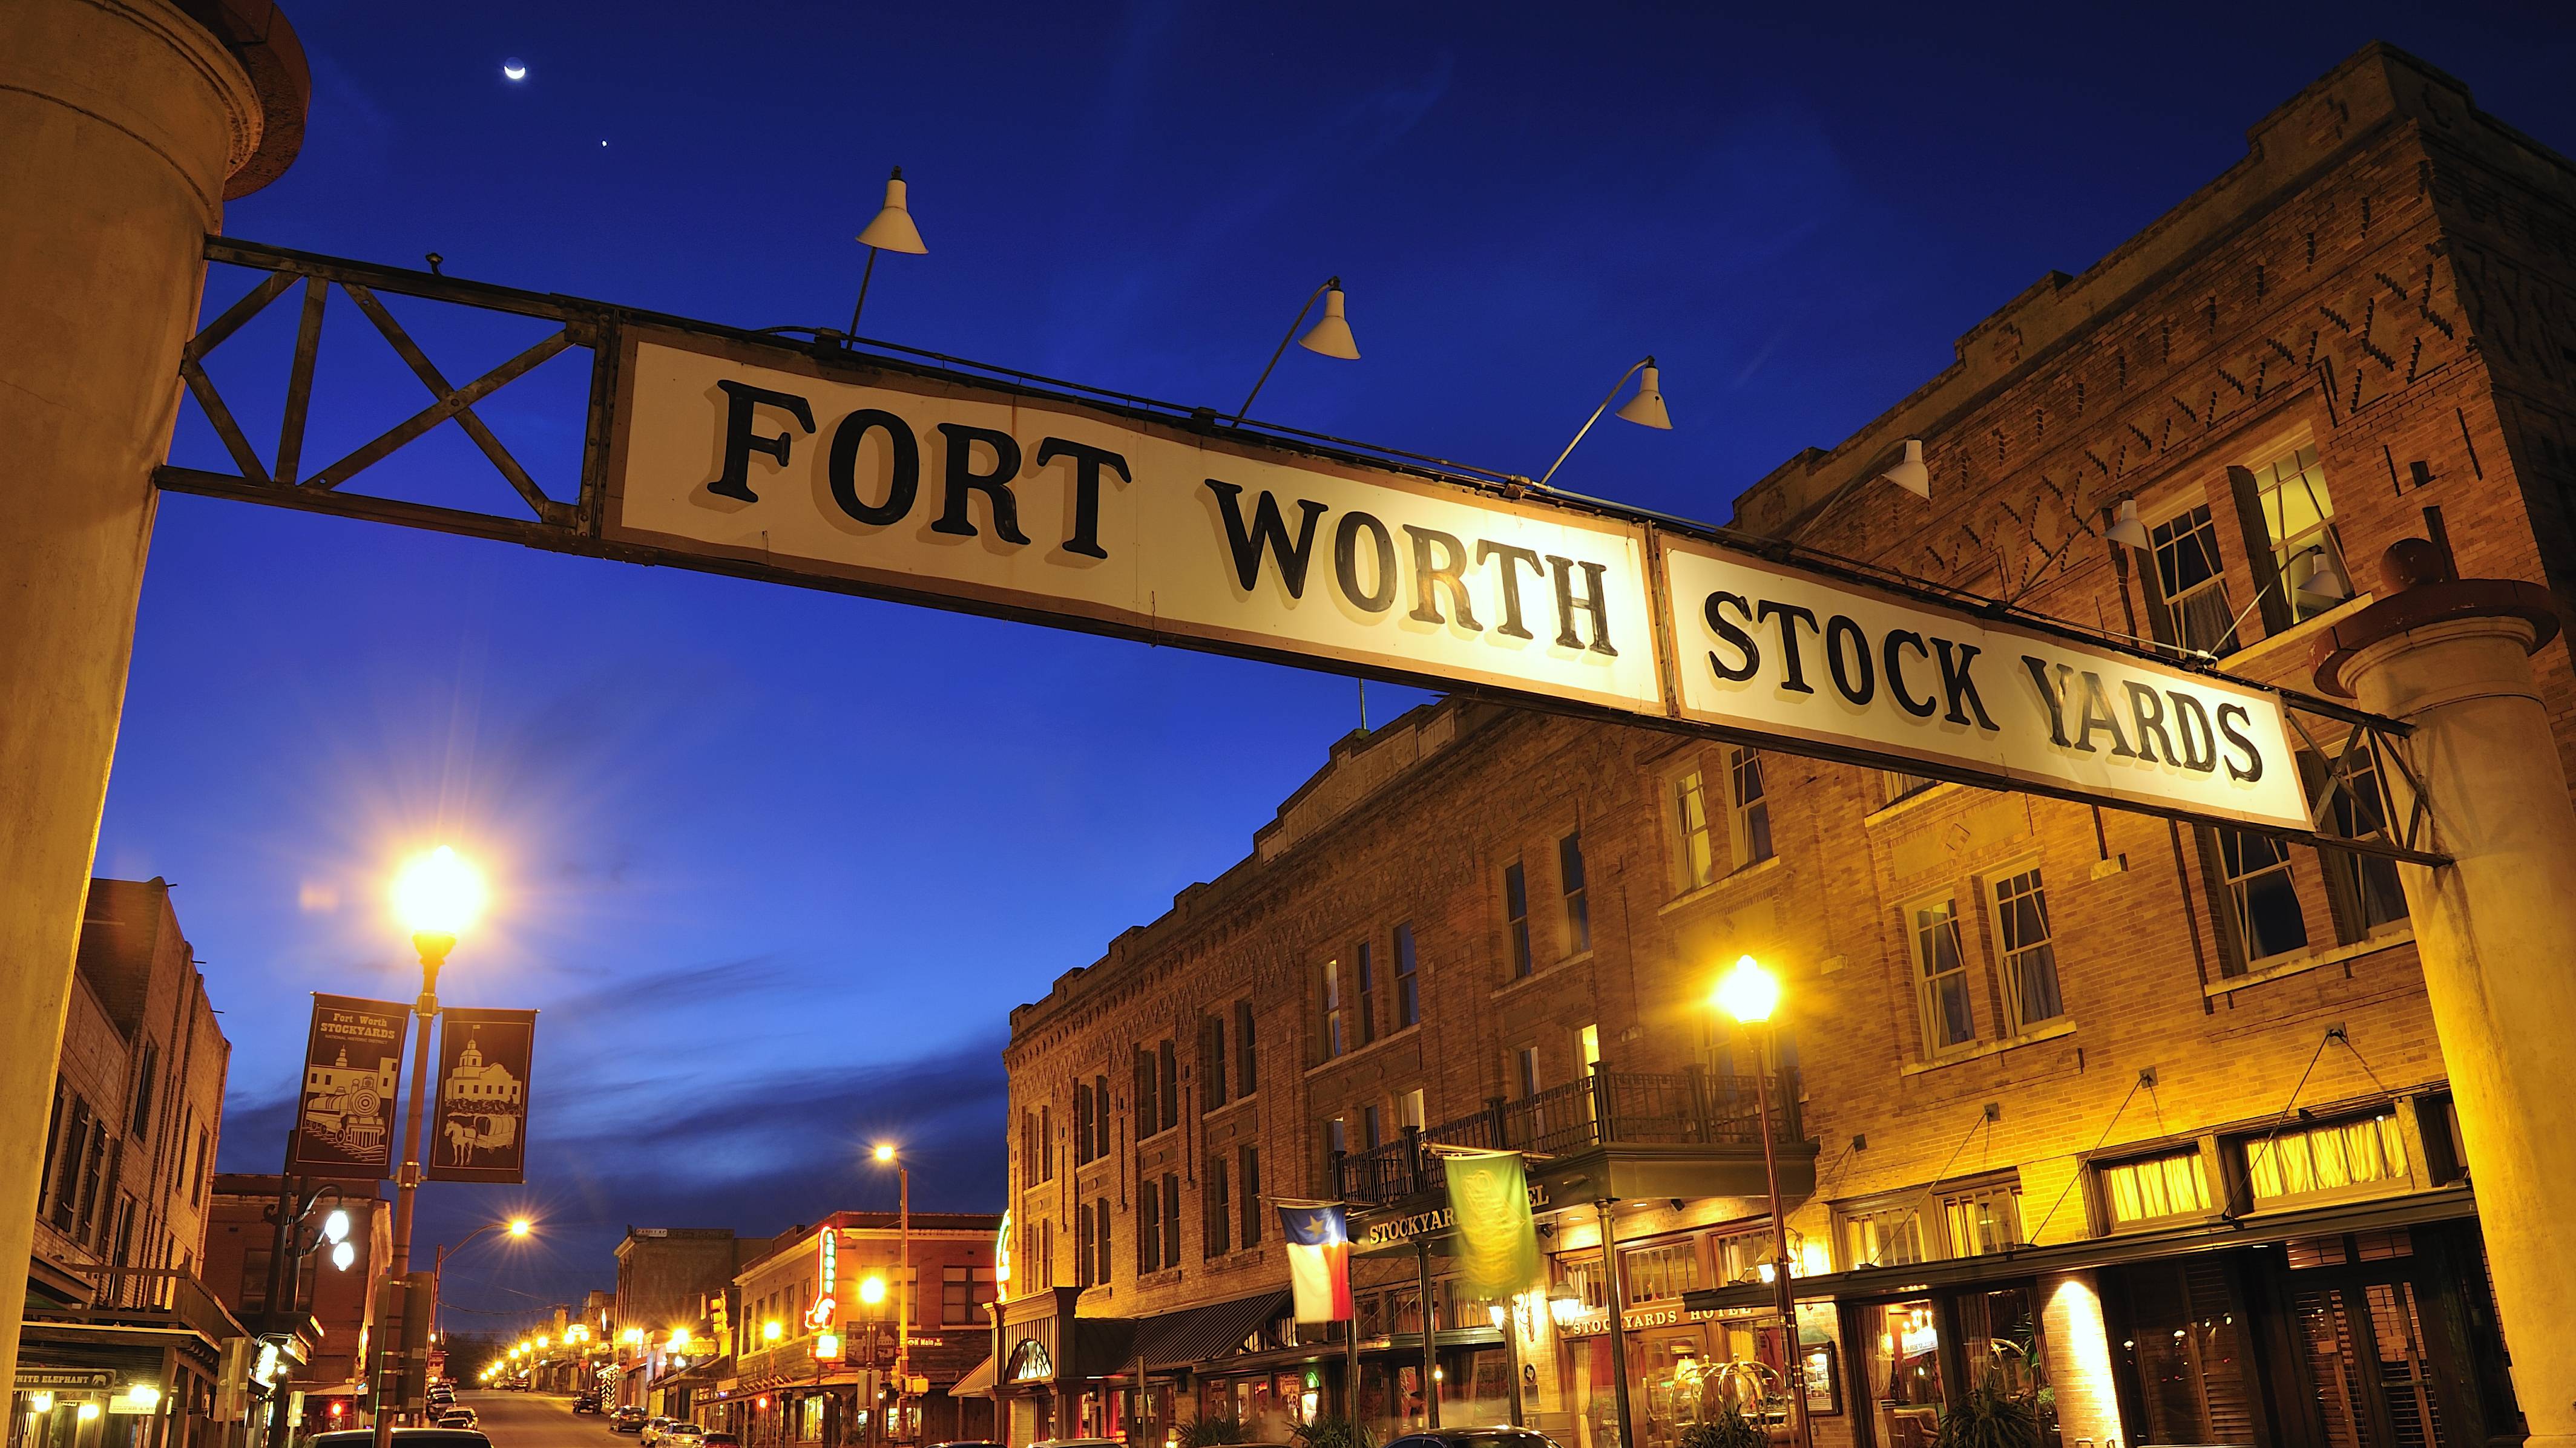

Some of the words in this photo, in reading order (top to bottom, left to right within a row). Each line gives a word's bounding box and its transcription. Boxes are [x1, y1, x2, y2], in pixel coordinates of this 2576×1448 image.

[707, 379, 1132, 560] FORT
[1204, 478, 1618, 657] WORTH
[1704, 591, 2000, 732] STOCK
[2022, 655, 2263, 782] YARDS
[320, 1023, 395, 1039] STOCKYARDS
[334, 1013, 353, 1023] Fort
[359, 1015, 387, 1027] Worth
[1369, 1207, 1459, 1245] STOCKYAR
[1574, 1311, 1677, 1335] STOCYARDS
